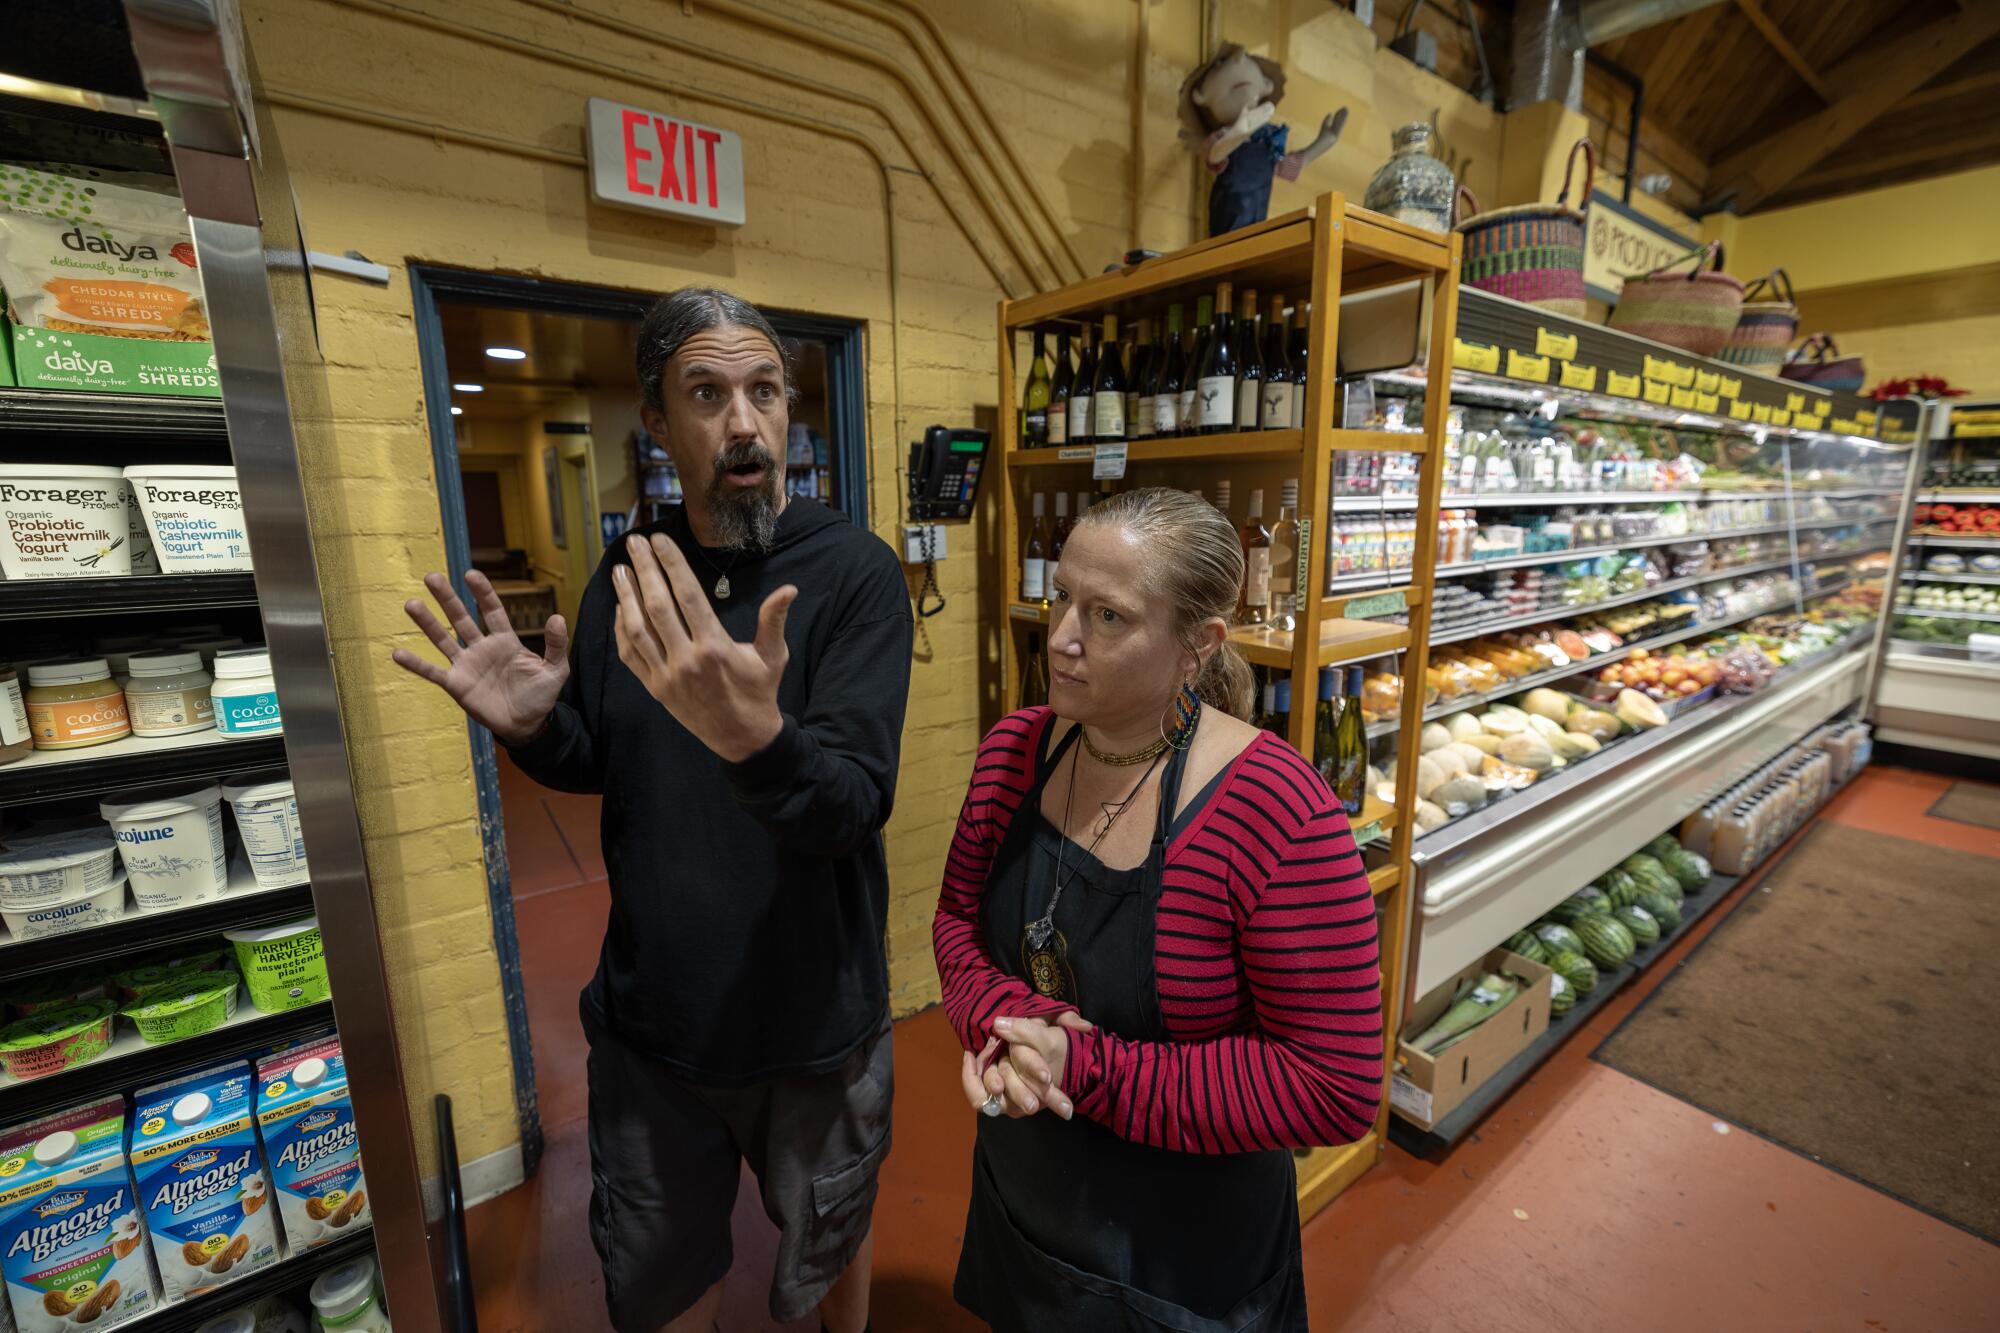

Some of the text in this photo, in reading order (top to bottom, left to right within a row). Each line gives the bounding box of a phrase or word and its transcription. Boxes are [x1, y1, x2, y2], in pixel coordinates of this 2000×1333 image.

[621, 109, 721, 209] EXIT
[61, 228, 158, 261] daiya
[50, 256, 177, 278] deliciously dairy-free
[70, 285, 175, 302] CHEDDAR STYLE
[90, 305, 163, 321] SHREDS
[45, 350, 114, 376] daiya
[139, 364, 211, 374] PLANT-BASED
[38, 373, 83, 386] deliciously
[137, 372, 218, 388] SHREDS
[0, 484, 107, 505] Forager
[143, 486, 238, 506] Forager
[82, 502, 120, 510] Project
[5, 511, 53, 520] Organic
[152, 511, 189, 520] Organic
[8, 519, 85, 531] Probiotic
[155, 519, 217, 530] Probiotic
[12, 530, 111, 543] Cashewmilk
[158, 529, 243, 541] Cashewmilk
[15, 542, 69, 556] Yogurt
[161, 541, 204, 554] Yogurt
[1297, 521, 1311, 611] CHARDONNAY
[128, 862, 157, 870] COCONUT
[27, 902, 92, 923] cocojune
[252, 931, 321, 954] HARMLESS
[259, 943, 316, 964] HARVEST
[256, 951, 325, 973] unsweetened
[278, 966, 305, 979] plain
[7, 1045, 60, 1060] HARMLESS
[13, 1052, 57, 1065] HARVEST
[283, 1043, 338, 1064] UNSWEETENED
[13, 1058, 66, 1073] strawberry
[220, 1084, 243, 1094] Vanilla
[25, 1110, 96, 1136] UNSWEETENED
[263, 1112, 284, 1122] 50%
[301, 1112, 334, 1128] DIAMOND
[309, 1113, 324, 1121] BLUE
[87, 1123, 118, 1137] Original
[143, 1121, 241, 1157] 50% MORE CALCIUM
[179, 1152, 215, 1168] DIAMOND
[188, 1151, 205, 1160] BLUE
[296, 1132, 356, 1172] Breeze
[150, 1149, 251, 1210] Almond
[301, 1162, 357, 1187] UNSWEETENED
[315, 1174, 346, 1190] Vanilla
[51, 1193, 70, 1204] BLUE
[172, 1173, 239, 1215] Breeze
[40, 1193, 82, 1212] DIAMOND
[7, 1189, 124, 1258] Almond
[192, 1213, 228, 1230] Vanilla
[32, 1214, 109, 1263] Breeze
[207, 1237, 221, 1245] 80
[38, 1247, 111, 1279] UNSWEETENED
[53, 1263, 101, 1286] Original
[72, 1284, 87, 1293] 30
